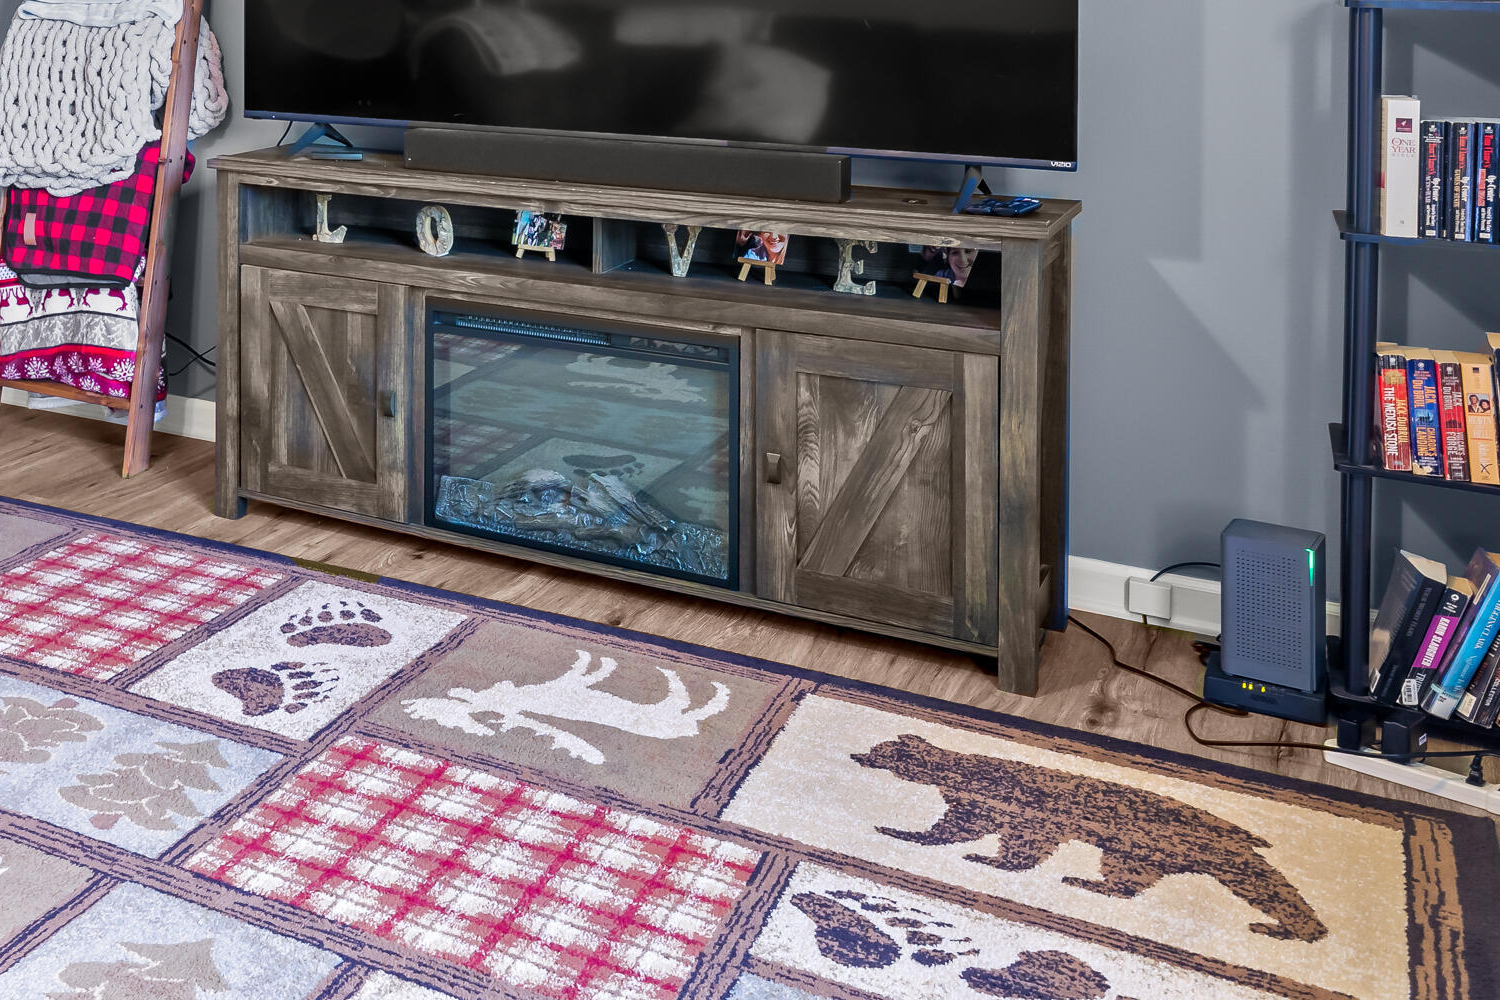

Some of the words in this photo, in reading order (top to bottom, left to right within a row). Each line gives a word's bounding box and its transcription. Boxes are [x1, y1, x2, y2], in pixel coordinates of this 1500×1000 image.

[1391, 137, 1416, 147] ONE
[1384, 387, 1395, 401] THE
[1424, 385, 1437, 404] JACK
[1384, 403, 1397, 432] MEDUSA
[1385, 433, 1399, 456] STONE
[1434, 617, 1450, 637] KARIN
[1421, 634, 1443, 667] SLAUGHTER
